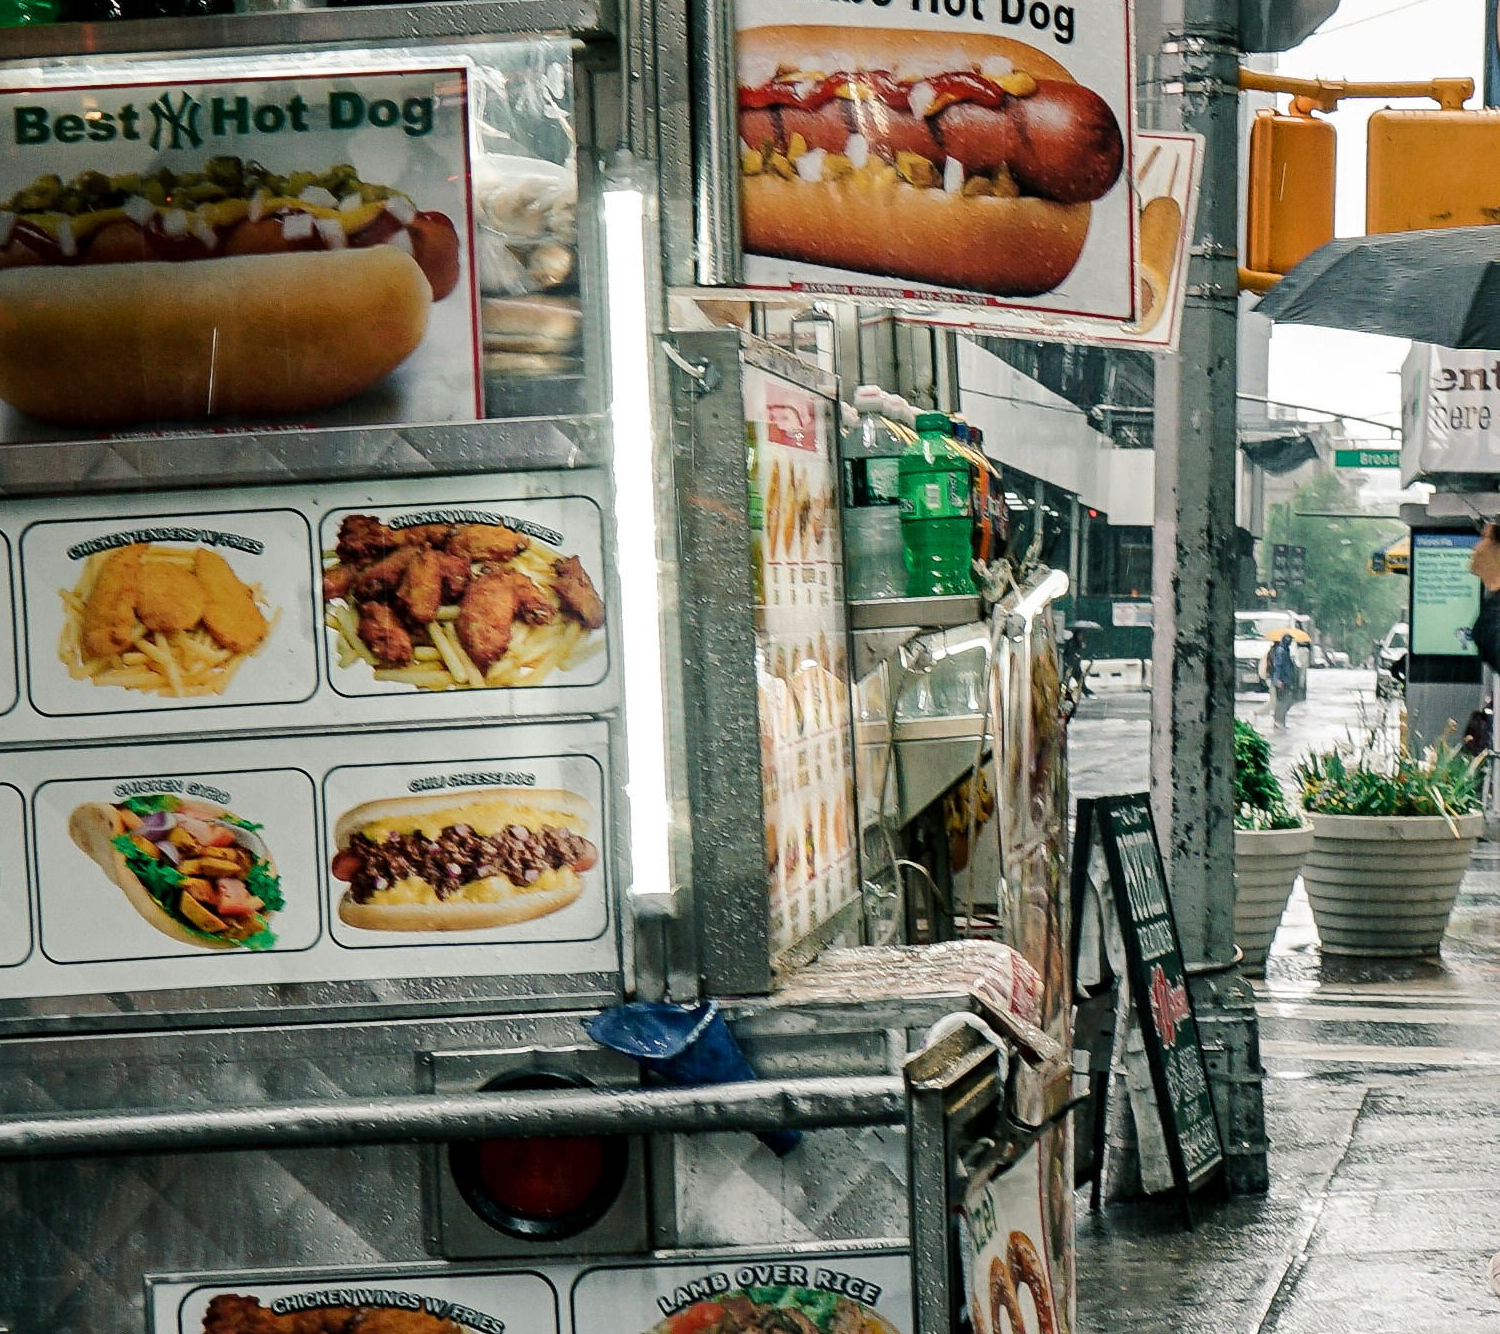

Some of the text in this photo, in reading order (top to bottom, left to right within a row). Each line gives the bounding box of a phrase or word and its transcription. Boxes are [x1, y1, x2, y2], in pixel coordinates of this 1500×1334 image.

[14, 101, 141, 147] Best
[211, 94, 309, 137] Hot
[329, 90, 435, 138] Dog
[67, 532, 131, 561] CHICKEN
[219, 533, 265, 556] FRIES
[270, 1287, 356, 1317] CHICKEN
[356, 1287, 421, 1313] WINGS
[657, 1265, 882, 1318] LAMB OVER RICE
